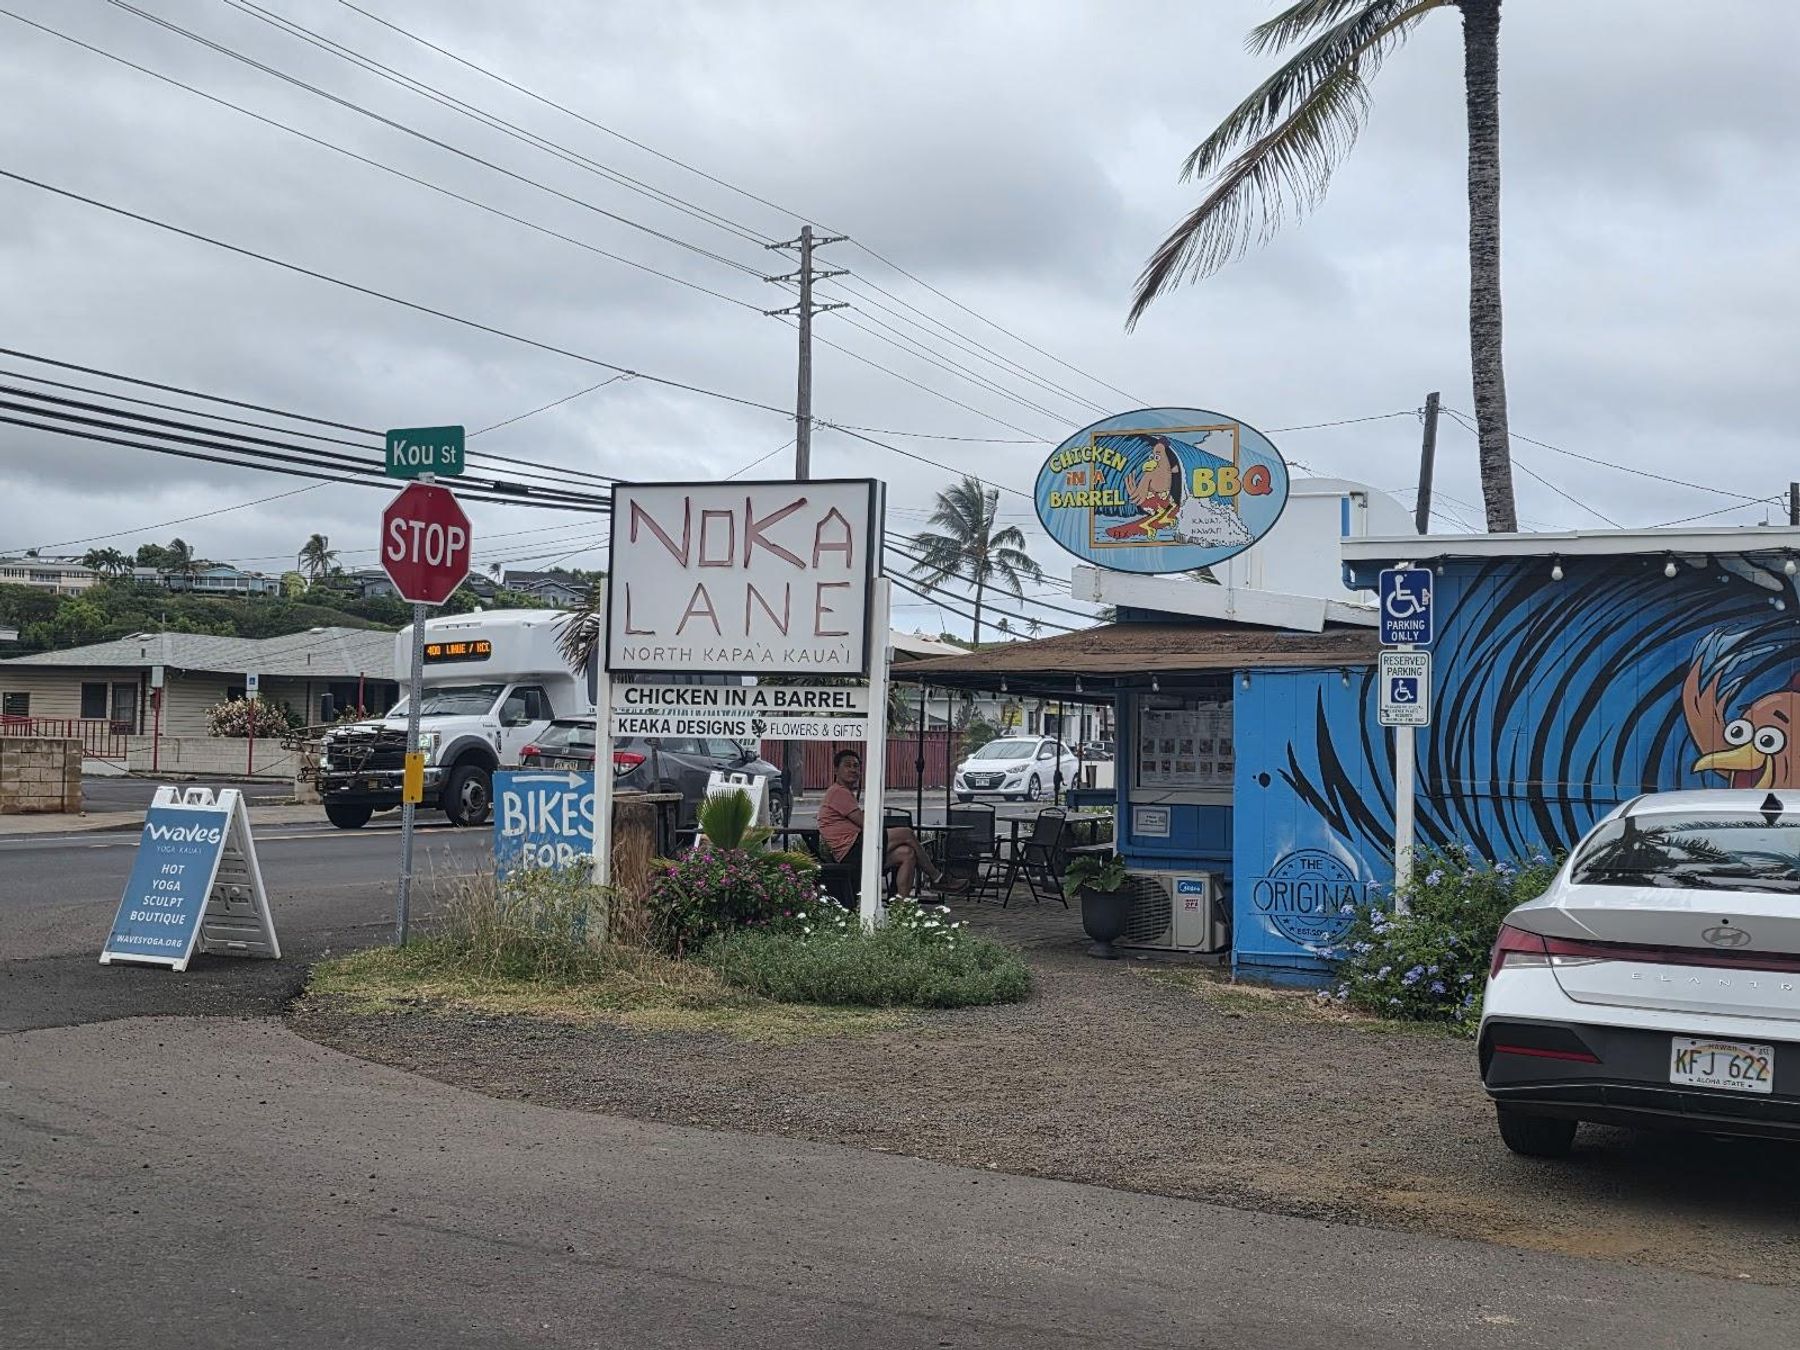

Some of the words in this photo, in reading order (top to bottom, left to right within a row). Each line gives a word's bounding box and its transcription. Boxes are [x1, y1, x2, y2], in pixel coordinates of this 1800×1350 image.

[393, 440, 434, 466] Kou
[441, 445, 457, 464] St
[1049, 445, 1129, 473] CHICKEN
[1066, 471, 1087, 486] IN
[1093, 469, 1106, 485] A
[1192, 464, 1273, 498] BBQ
[1050, 489, 1126, 509] BARREL
[629, 495, 853, 569] NOKA
[387, 517, 466, 568] STOP
[624, 581, 851, 637] LANE
[1386, 619, 1426, 631] PARKING
[1391, 631, 1419, 642] ONLY
[623, 647, 692, 662] NORTH
[1384, 655, 1427, 666] RESERVED
[1386, 667, 1423, 677] PARKING
[624, 687, 718, 707] CHICKEN
[725, 689, 747, 707] IN
[752, 689, 768, 707] A
[774, 690, 857, 709] BARREL
[618, 717, 671, 734] KEAKA
[676, 719, 746, 736] DESIGNS
[770, 722, 819, 737] FLOWERS
[822, 724, 829, 737] &
[833, 723, 862, 738] GIFTS
[502, 789, 595, 839] BIKES
[523, 843, 573, 871] FOR
[1300, 859, 1323, 870] THE
[161, 864, 185, 876] HOT
[152, 879, 181, 892] YOGA
[142, 895, 184, 908] SCULPT
[130, 910, 186, 926] BOUTIQUE
[116, 934, 183, 948] WAVESYOGA.ORG
[1675, 1048, 1716, 1076] KFJ
[1728, 1054, 1769, 1082] 622
[1696, 1076, 1721, 1086] ALOHA
[1724, 1079, 1746, 1088] STATE
